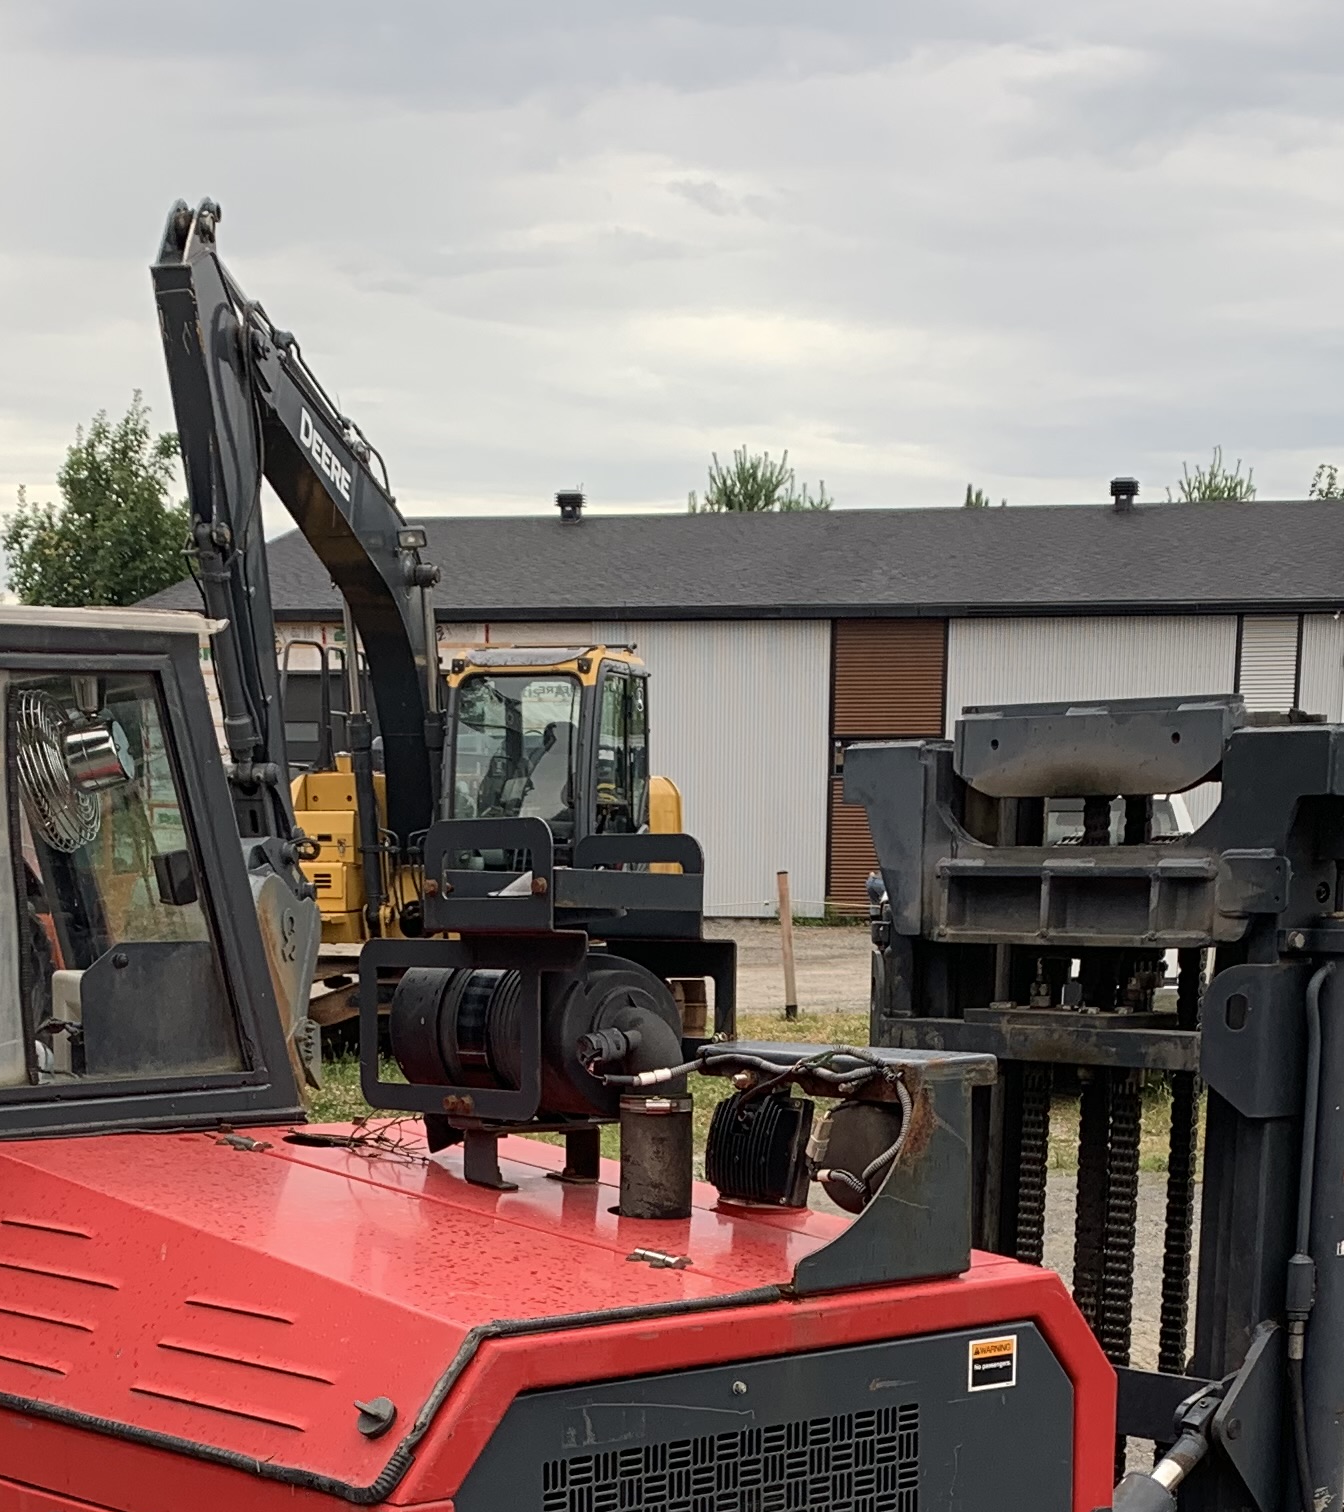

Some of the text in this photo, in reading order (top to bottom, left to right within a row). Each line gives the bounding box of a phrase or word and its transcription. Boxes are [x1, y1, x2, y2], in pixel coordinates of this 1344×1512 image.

[300, 407, 352, 502] DEERE
[980, 1343, 1011, 1354] WARNING
[974, 1363, 982, 1371] No
